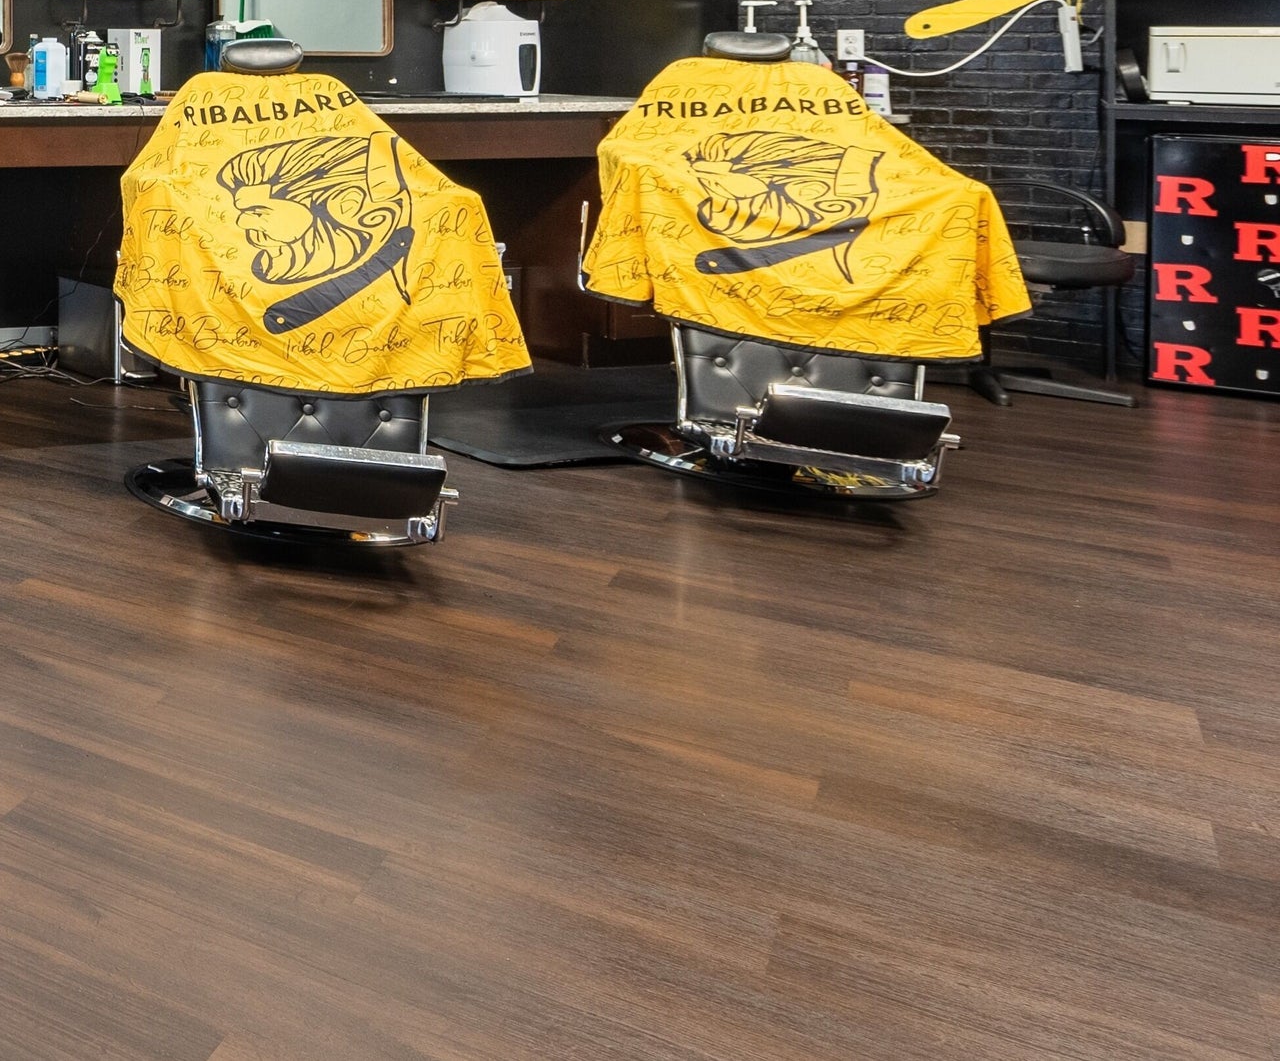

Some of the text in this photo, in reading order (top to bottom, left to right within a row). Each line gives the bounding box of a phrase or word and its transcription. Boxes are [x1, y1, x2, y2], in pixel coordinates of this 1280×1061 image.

[174, 91, 357, 128] RIBALBARB
[1241, 144, 1280, 184] R
[1154, 175, 1218, 217] R
[143, 208, 194, 241] Tribal
[1233, 222, 1280, 264] R
[134, 255, 190, 292] Barbers
[1153, 263, 1218, 303] R
[133, 309, 186, 340] Tribal
[192, 315, 262, 351] Barbers
[342, 324, 410, 363] Barbers
[1235, 307, 1280, 348] R
[1153, 341, 1215, 386] R
